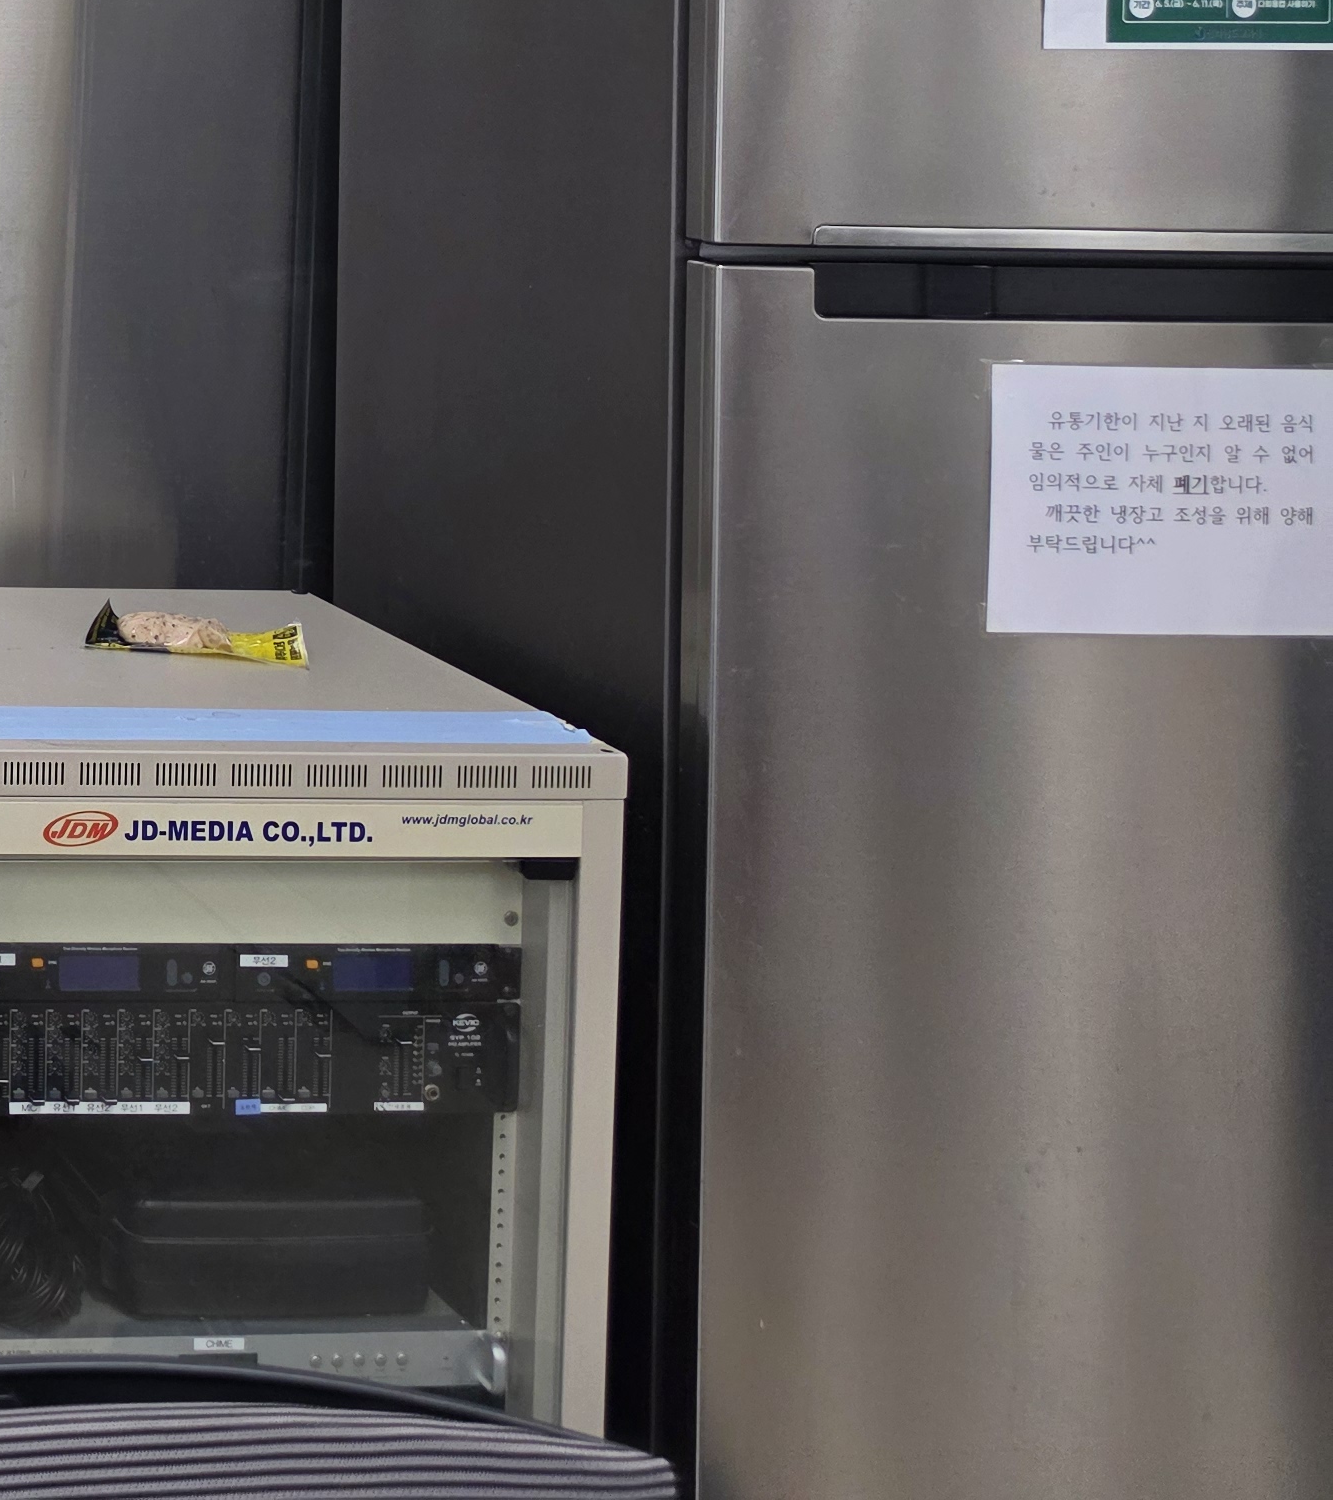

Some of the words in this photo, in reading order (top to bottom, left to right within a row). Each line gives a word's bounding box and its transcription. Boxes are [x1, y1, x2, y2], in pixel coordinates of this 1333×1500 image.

[1047, 410, 1138, 432] 유통기한이
[1148, 412, 1184, 432] 지난
[1193, 412, 1209, 432] 지
[1218, 413, 1271, 434] 오래된
[1280, 414, 1315, 434] 음식
[1028, 441, 1065, 462] 물은
[1075, 442, 1130, 463] 주인이
[1142, 443, 1211, 463] 누구인지
[1223, 444, 1242, 464] 알
[1252, 444, 1271, 464] 수
[1281, 444, 1315, 465] 없어
[1028, 472, 1120, 493] 임의적으로
[1128, 474, 1164, 494] 자체
[1172, 474, 1268, 495] 폐기합니다.
[1044, 503, 1101, 524] 깨끗한
[1110, 504, 1164, 525] 냉장고
[1173, 505, 1226, 526] 조성을
[1235, 506, 1270, 526] 위해
[1280, 506, 1315, 527] 양해
[50, 818, 111, 840] JDM
[401, 813, 534, 828] www.jdmglobal.co.kr
[124, 819, 254, 843] JD-MEDIA
[262, 820, 374, 848] CO.,LTD.
[252, 956, 277, 966] 무선2
[120, 1103, 144, 1112] 무선1
[153, 1103, 179, 1113] 무선2
[205, 1339, 234, 1349] CHIME
